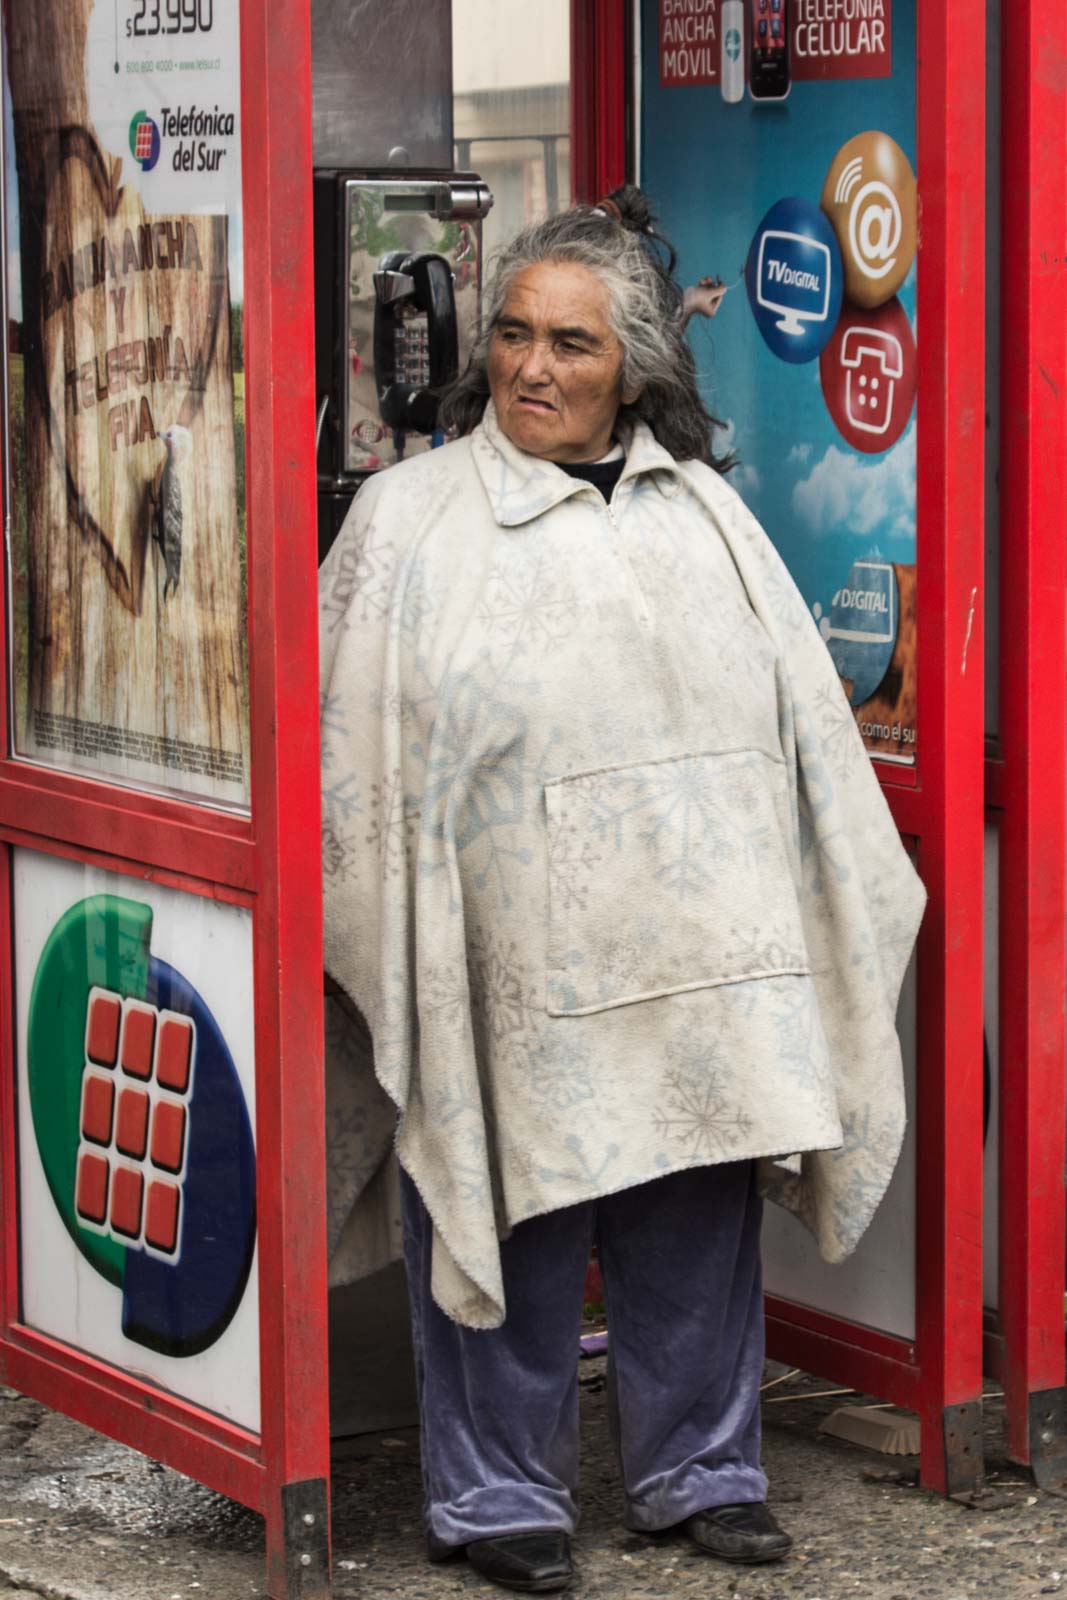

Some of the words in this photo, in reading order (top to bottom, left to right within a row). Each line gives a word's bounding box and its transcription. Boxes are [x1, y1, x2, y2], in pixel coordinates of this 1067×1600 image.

[126, 0, 213, 38] $23.990
[663, 0, 716, 15] BANDA
[663, 16, 716, 43] ANCHA
[795, 21, 886, 56] CELULAR
[126, 61, 139, 73] 600
[156, 59, 173, 72] 4000
[663, 42, 716, 78] MÓVIL
[161, 105, 234, 137] Telefónica
[173, 141, 194, 172] del
[197, 142, 222, 172] Sur
[122, 221, 204, 274] ANCHA
[110, 286, 126, 333] Y
[109, 396, 156, 451] FIJA
[861, 722, 890, 741] como
[891, 722, 902, 742] el
